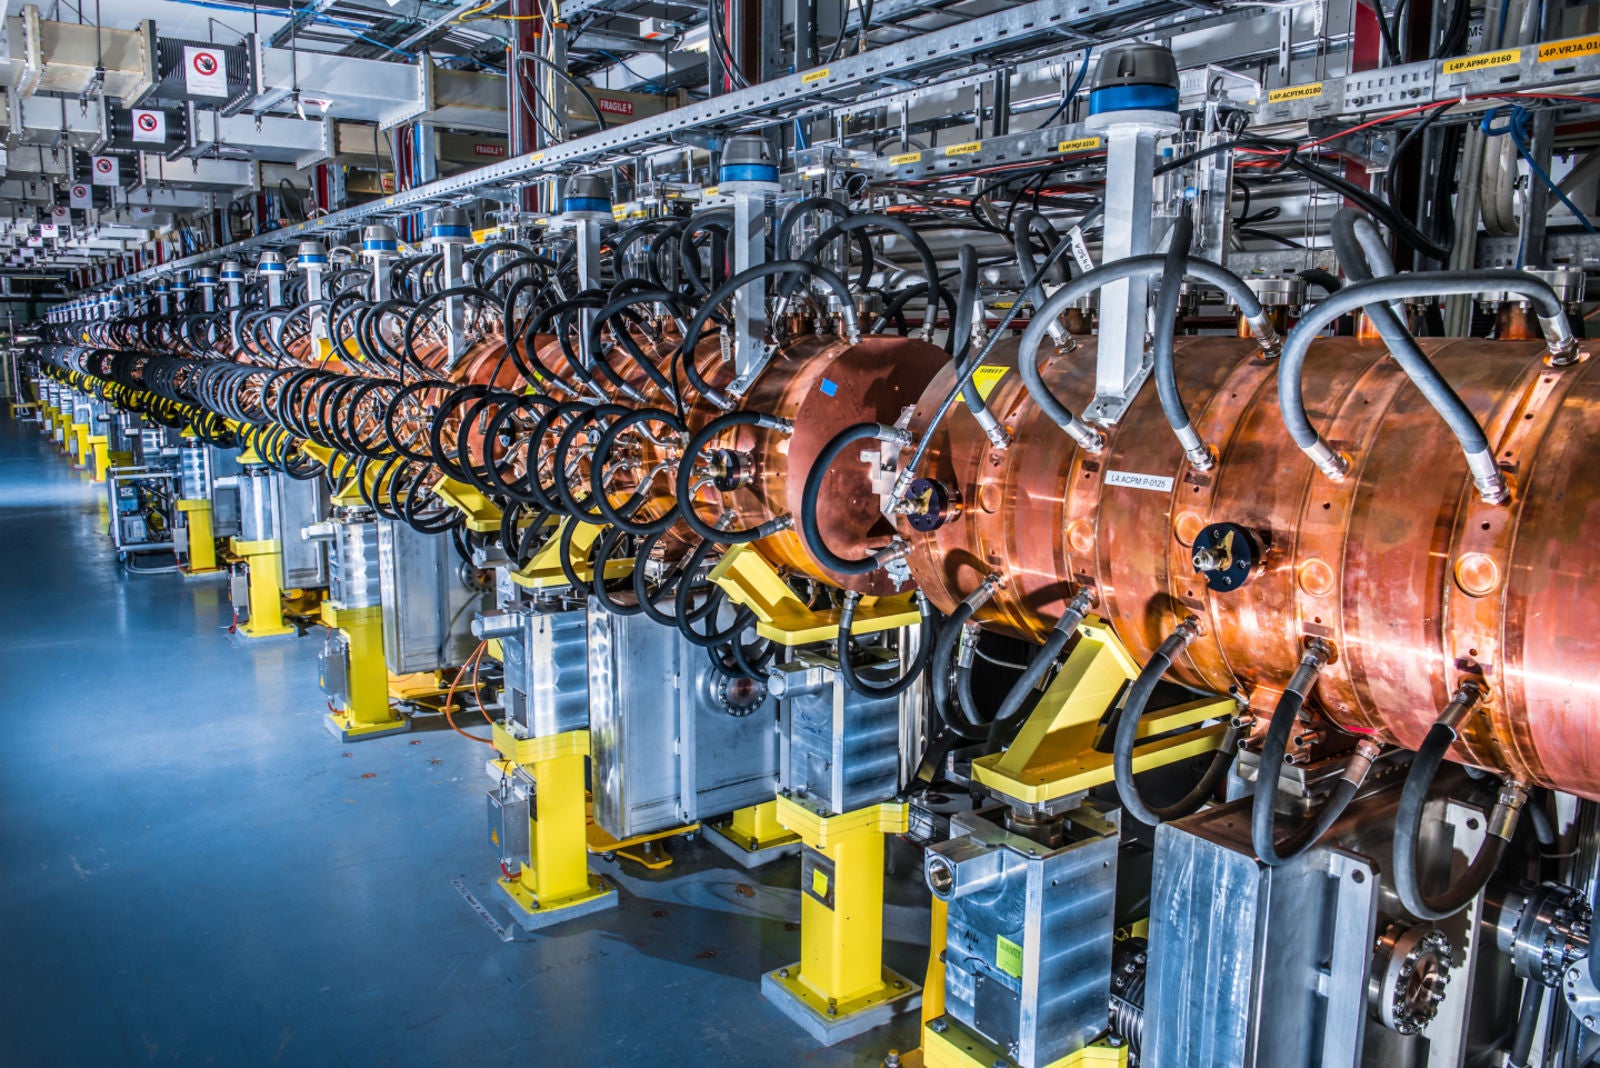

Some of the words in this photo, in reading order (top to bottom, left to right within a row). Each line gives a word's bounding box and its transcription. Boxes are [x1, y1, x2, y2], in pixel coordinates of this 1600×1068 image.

[1538, 41, 1600, 57] L4P.VRJA.01
[1450, 54, 1512, 71] L4P.APMP.0160
[600, 99, 627, 112] FRAGILE
[476, 145, 499, 154] FRAGILE
